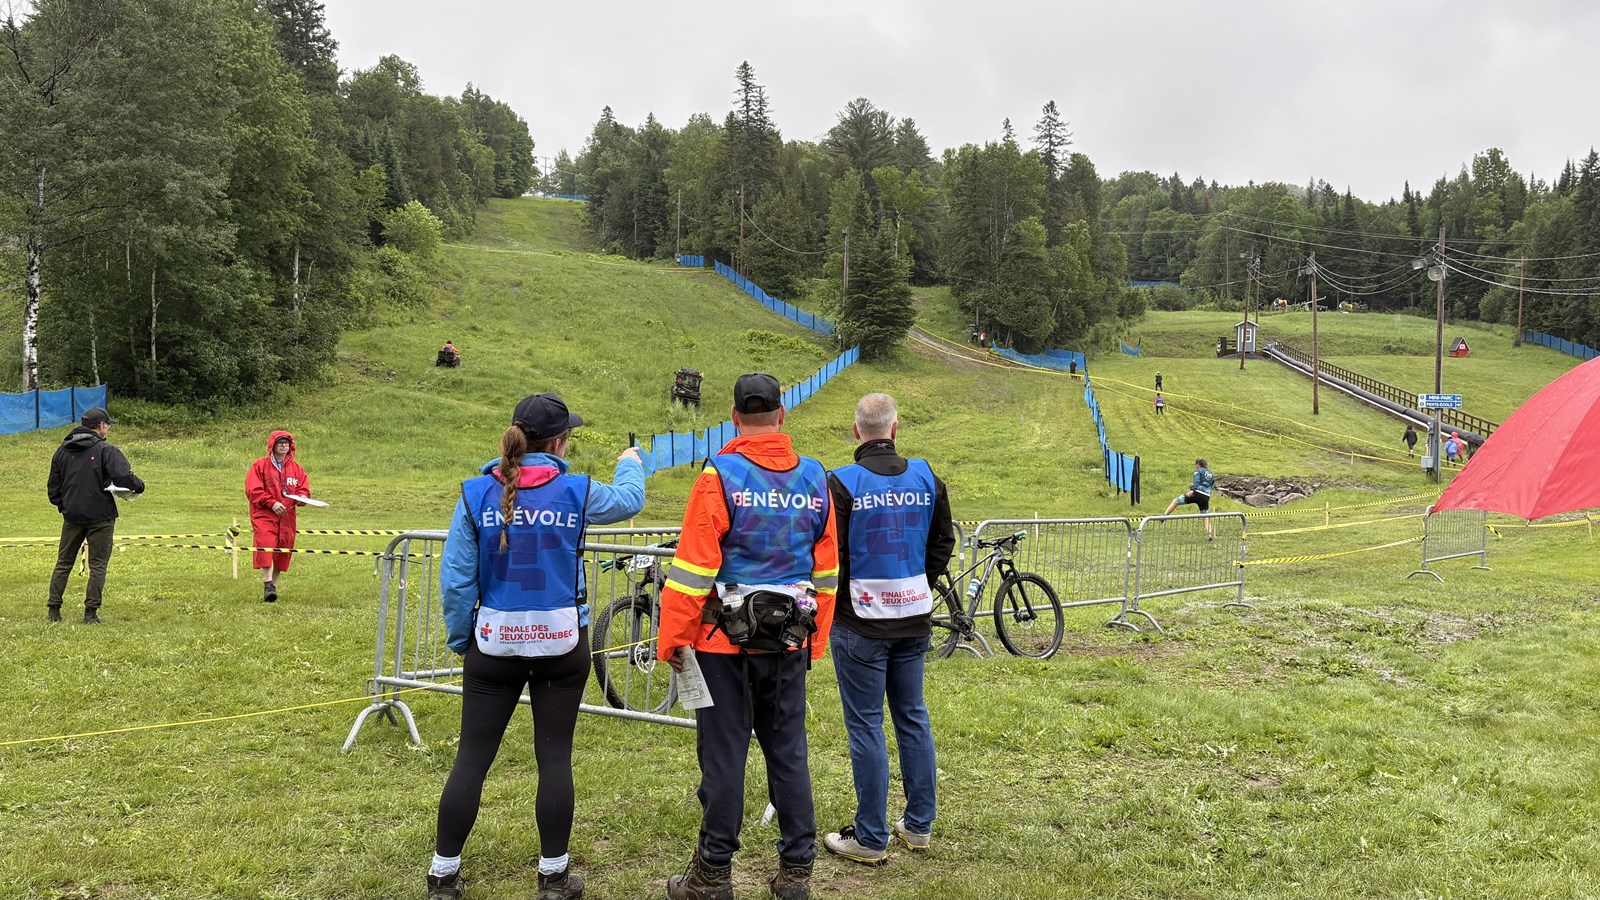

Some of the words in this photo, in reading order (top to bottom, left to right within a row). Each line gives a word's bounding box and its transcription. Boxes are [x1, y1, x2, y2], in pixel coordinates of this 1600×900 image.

[731, 488, 823, 512] BÉNÉVOLE
[852, 490, 931, 511] BÉNÉVOLE
[478, 506, 579, 528] ÉNÉVOLE
[881, 590, 905, 598] FINALE
[902, 596, 911, 604] DU
[499, 625, 530, 633] FINALE
[531, 624, 549, 632] DES
[499, 633, 523, 641] JEUX
[524, 633, 536, 641] DU
